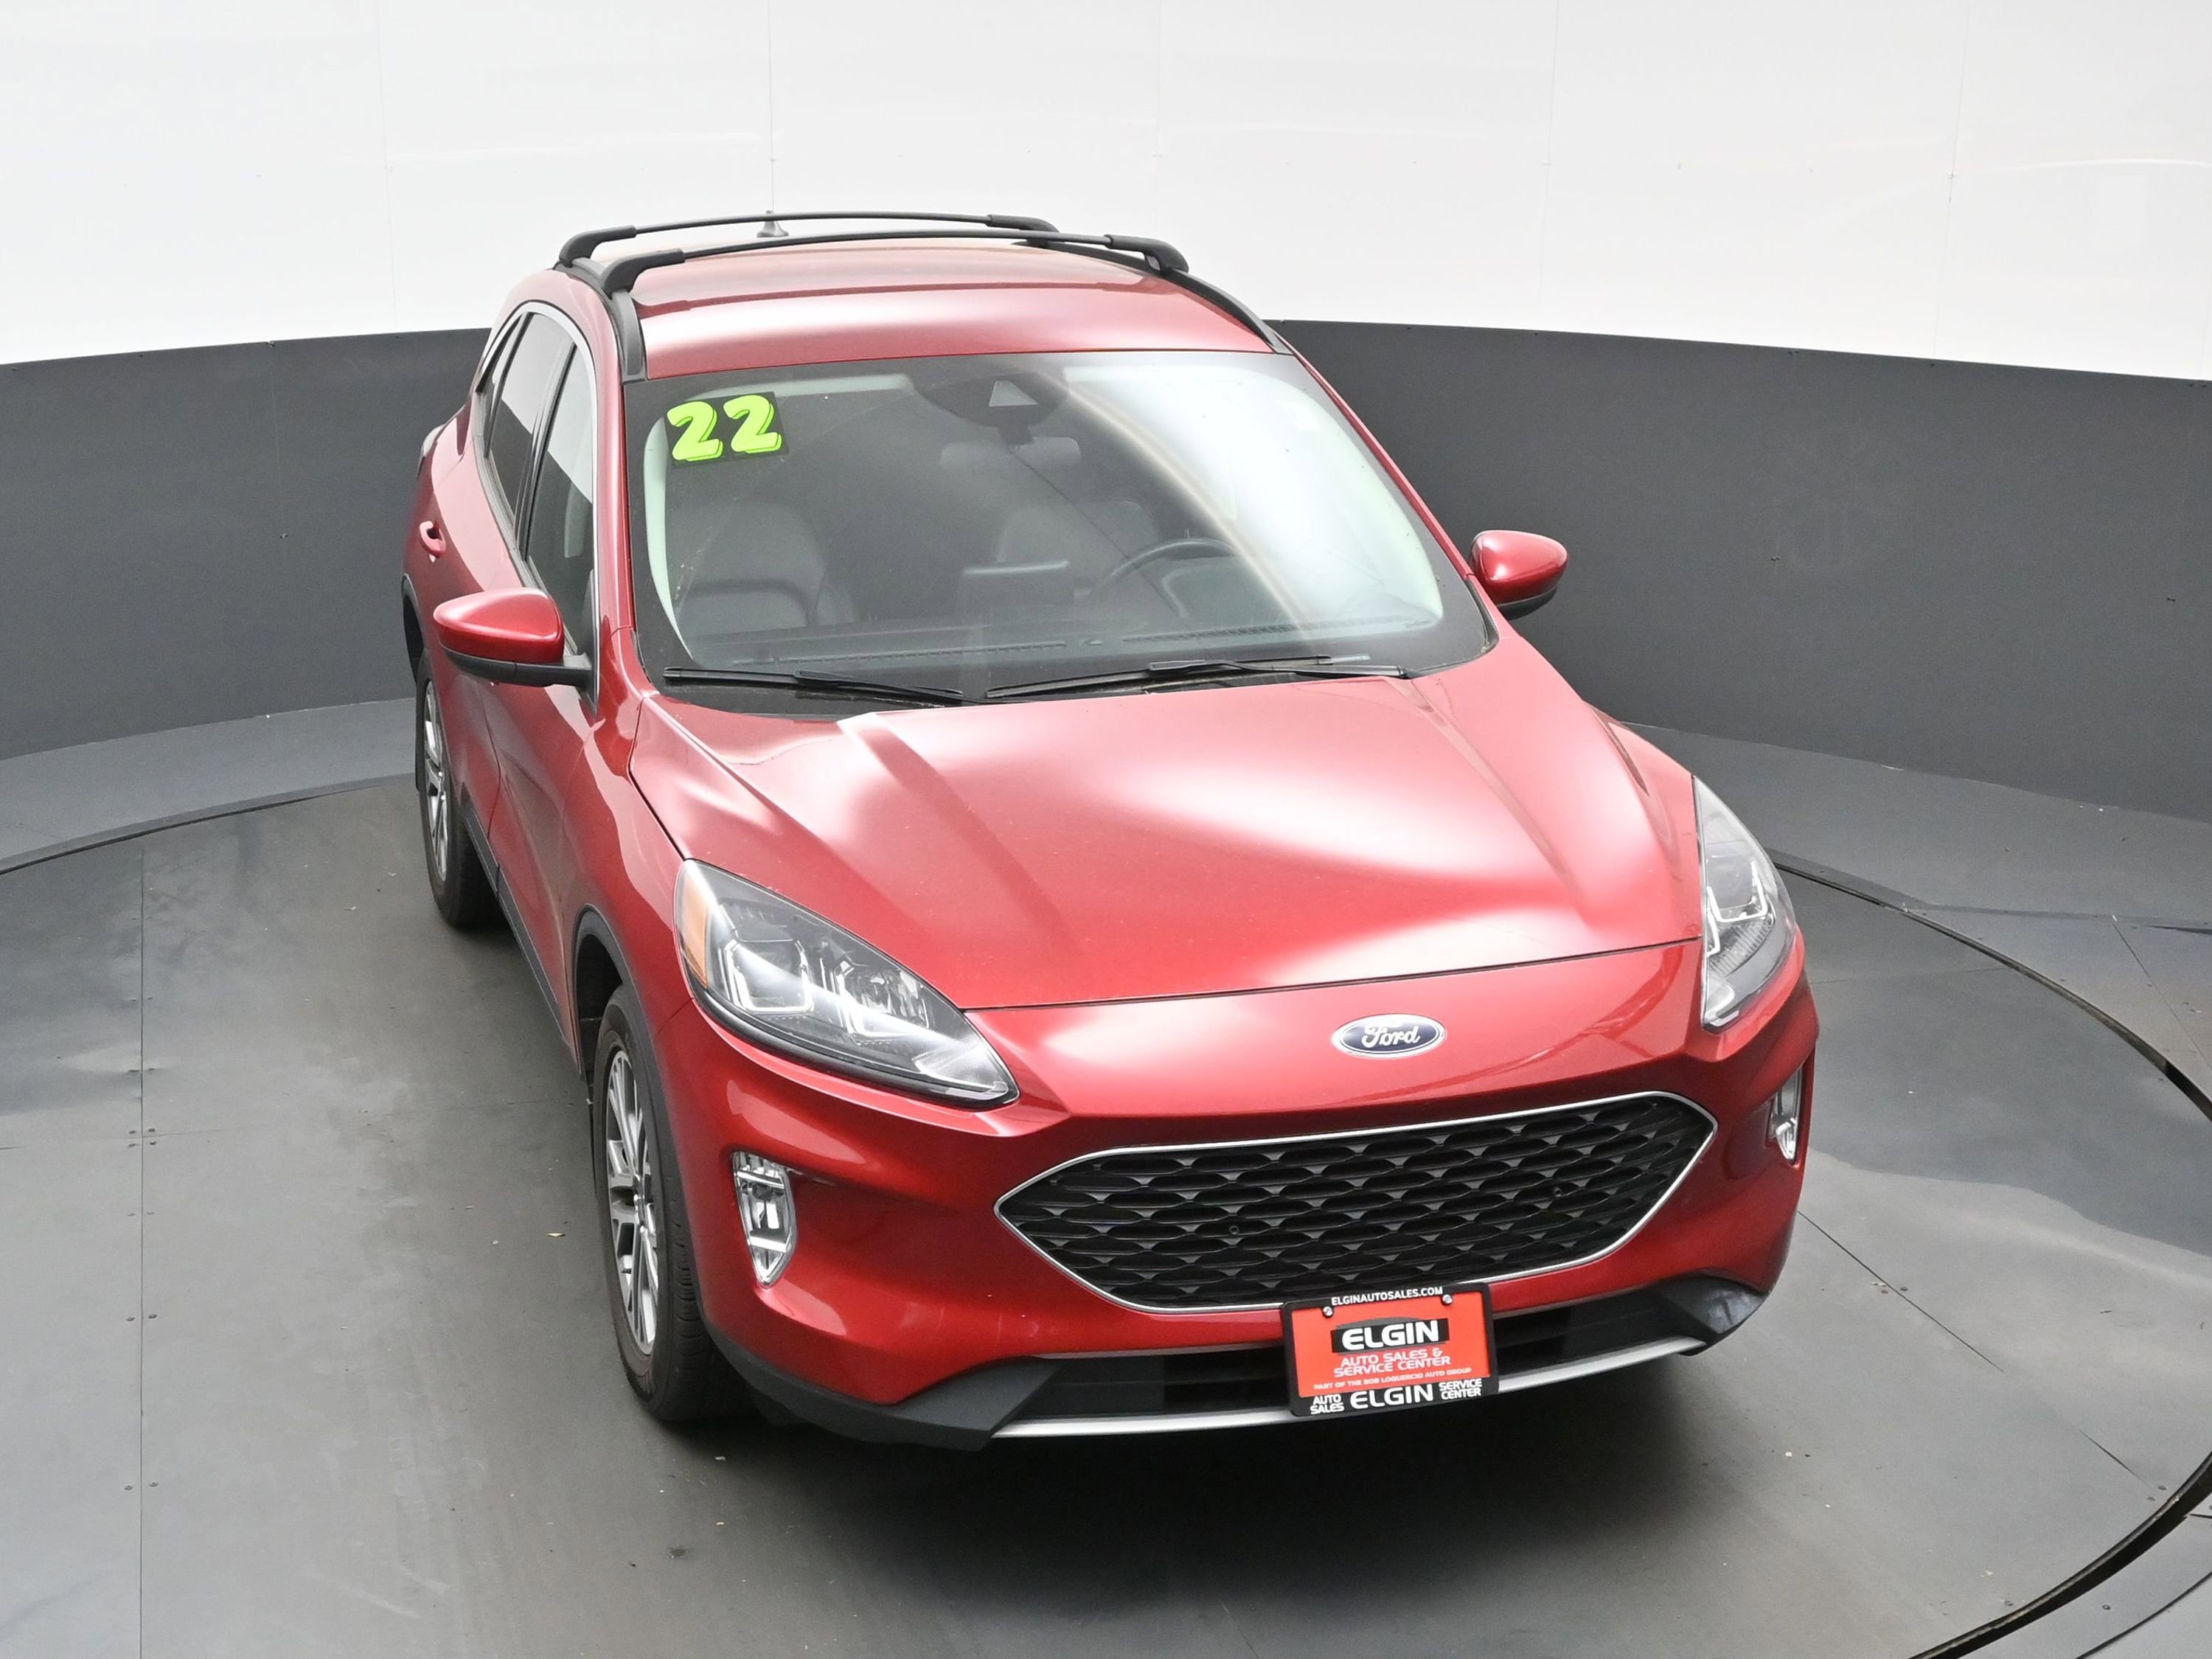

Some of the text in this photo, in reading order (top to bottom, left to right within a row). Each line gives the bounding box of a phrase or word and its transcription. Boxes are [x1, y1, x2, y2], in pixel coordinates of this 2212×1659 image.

[667, 394, 782, 462] 22
[1362, 1026, 1421, 1048] Ford
[1331, 1287, 1443, 1306] ELGINAUTOSALES.COM
[1342, 1320, 1439, 1351] ELGIN
[1333, 1355, 1451, 1377] SERVICE CENTER
[1340, 1347, 1443, 1367] AUTO SALES &
[1425, 1370, 1445, 1378] AUTO
[1446, 1367, 1472, 1376] GROUP
[1439, 1378, 1482, 1391] SERVICE
[1441, 1388, 1481, 1400] CENTER
[1312, 1394, 1342, 1405] AUTO
[1350, 1383, 1433, 1409] ELGIN
[1310, 1402, 1345, 1415] SALES
